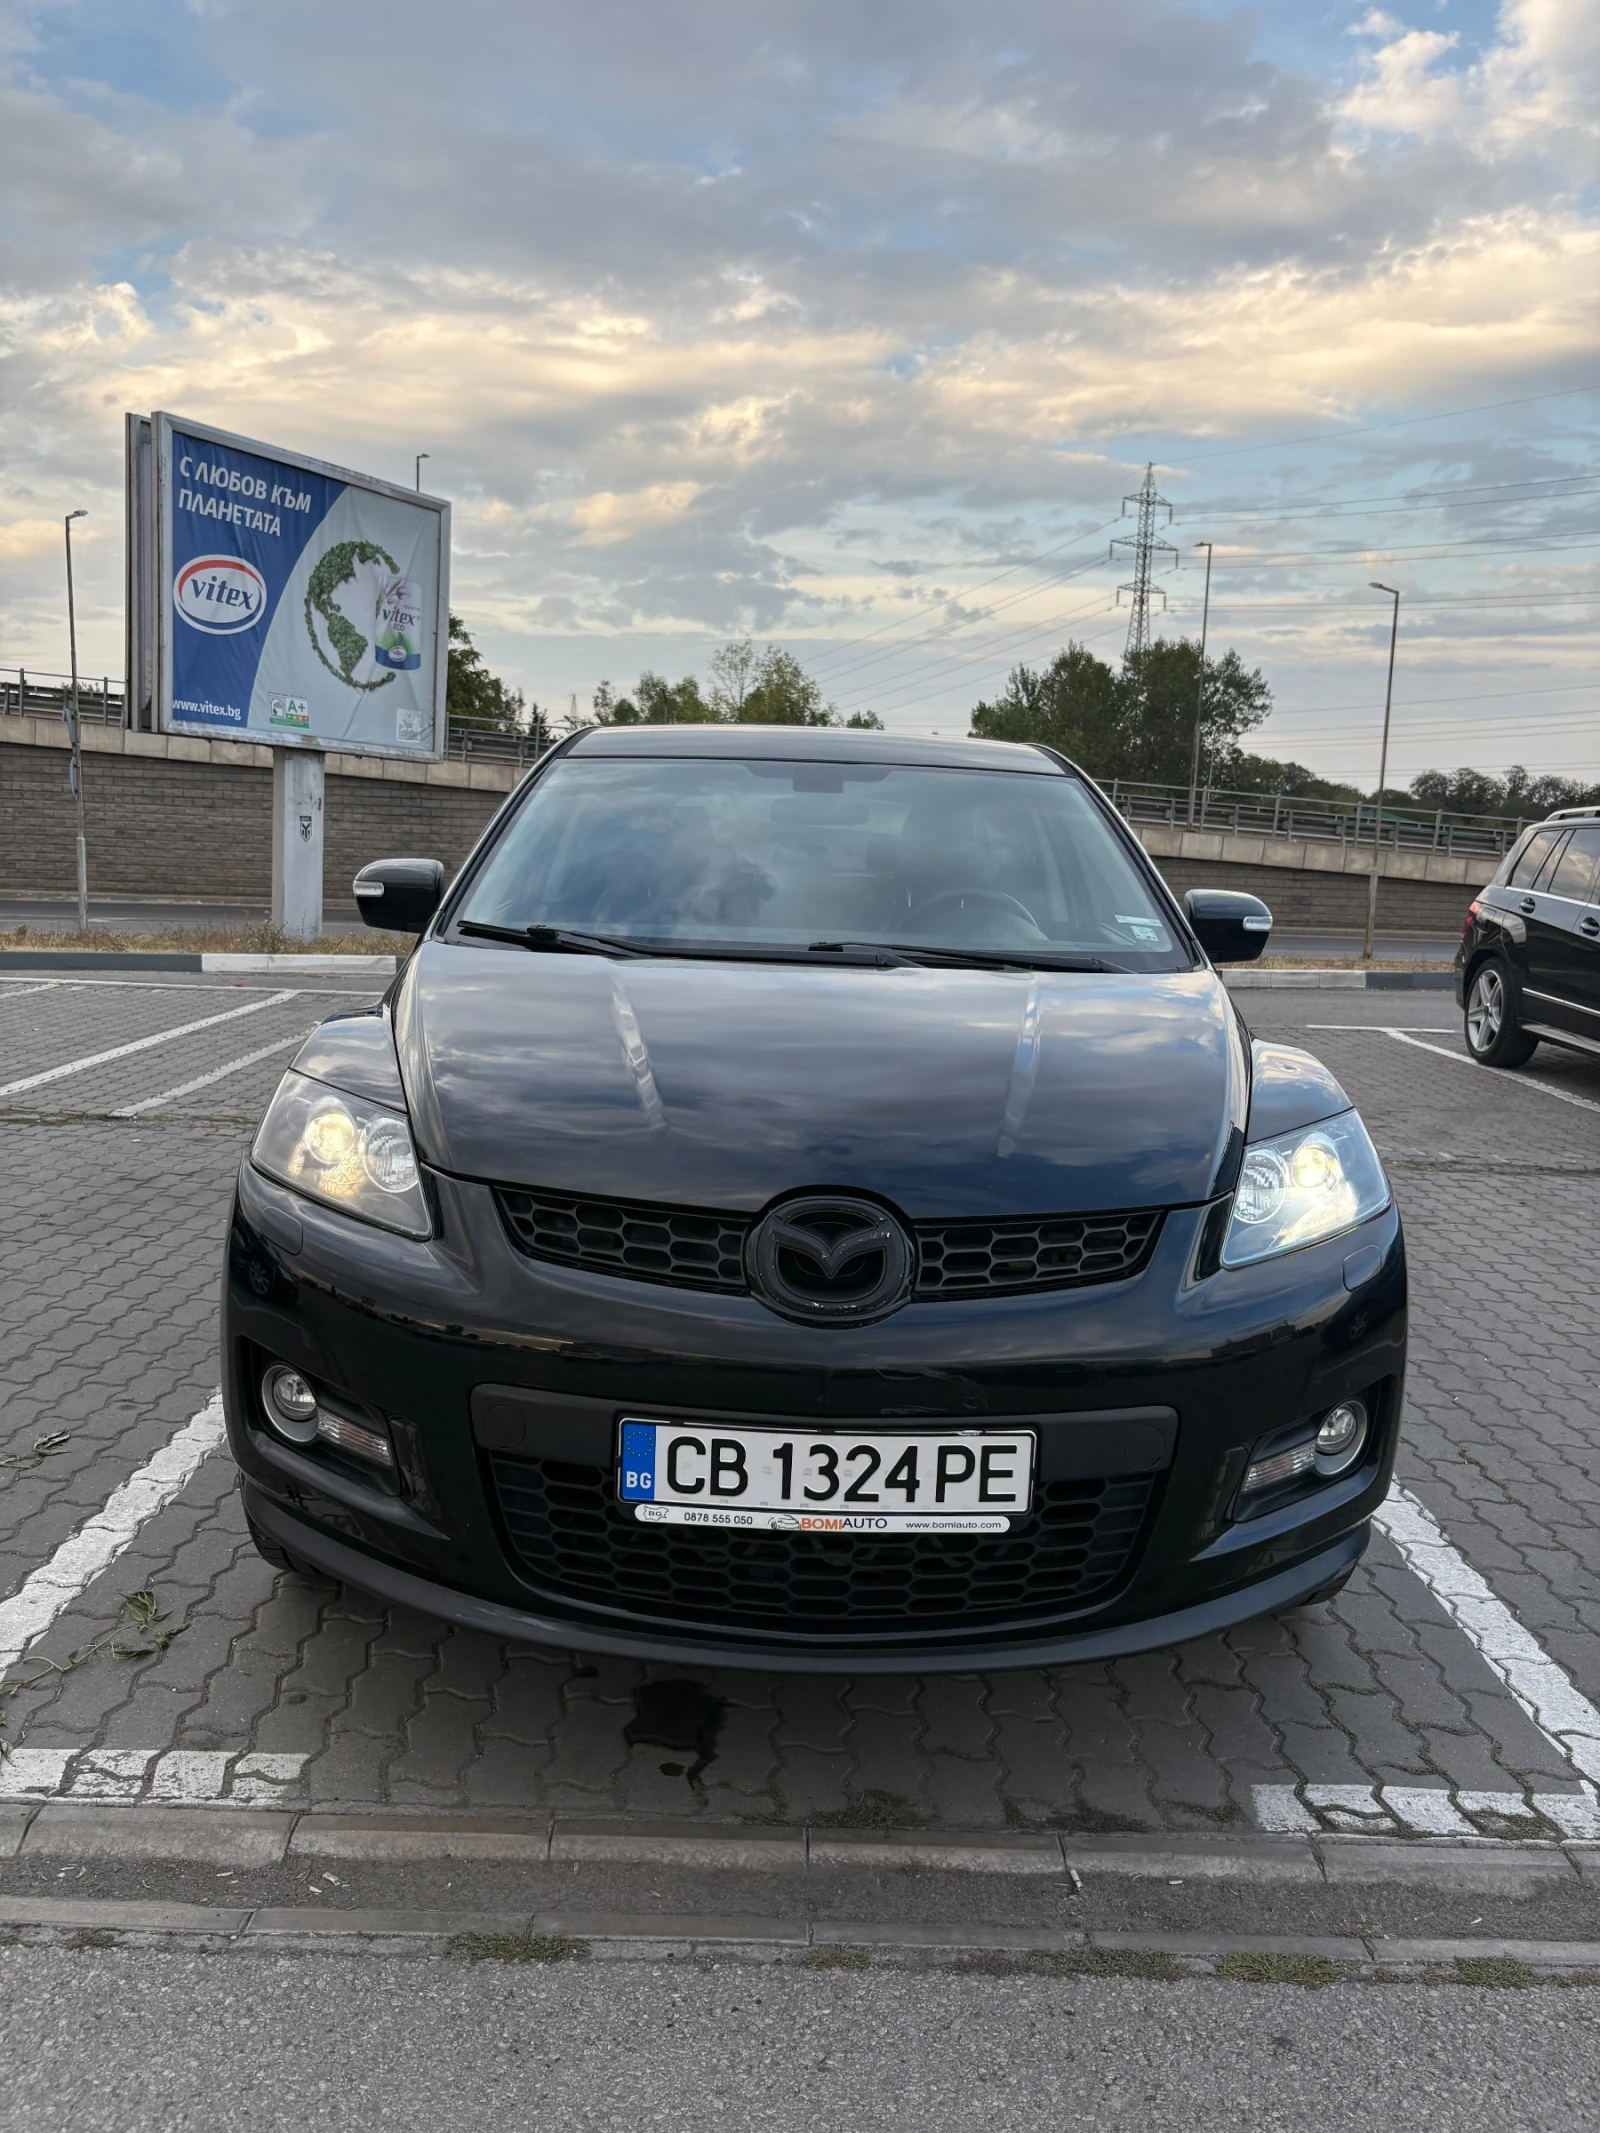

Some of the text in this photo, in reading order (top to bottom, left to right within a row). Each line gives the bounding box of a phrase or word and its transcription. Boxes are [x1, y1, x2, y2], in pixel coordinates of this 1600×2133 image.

[180, 456, 312, 514] С ЛЮБОВ КЪМ
[178, 488, 281, 537] ПЛАНЕТАТА
[191, 575, 253, 610] vitex
[172, 699, 242, 721] www.vitex.bg
[287, 699, 306, 713] A+
[667, 1435, 749, 1497] CB
[626, 1471, 652, 1489] BG
[684, 1511, 753, 1525] 0878 555 050
[905, 1521, 1002, 1529] www.bomiauto.com
